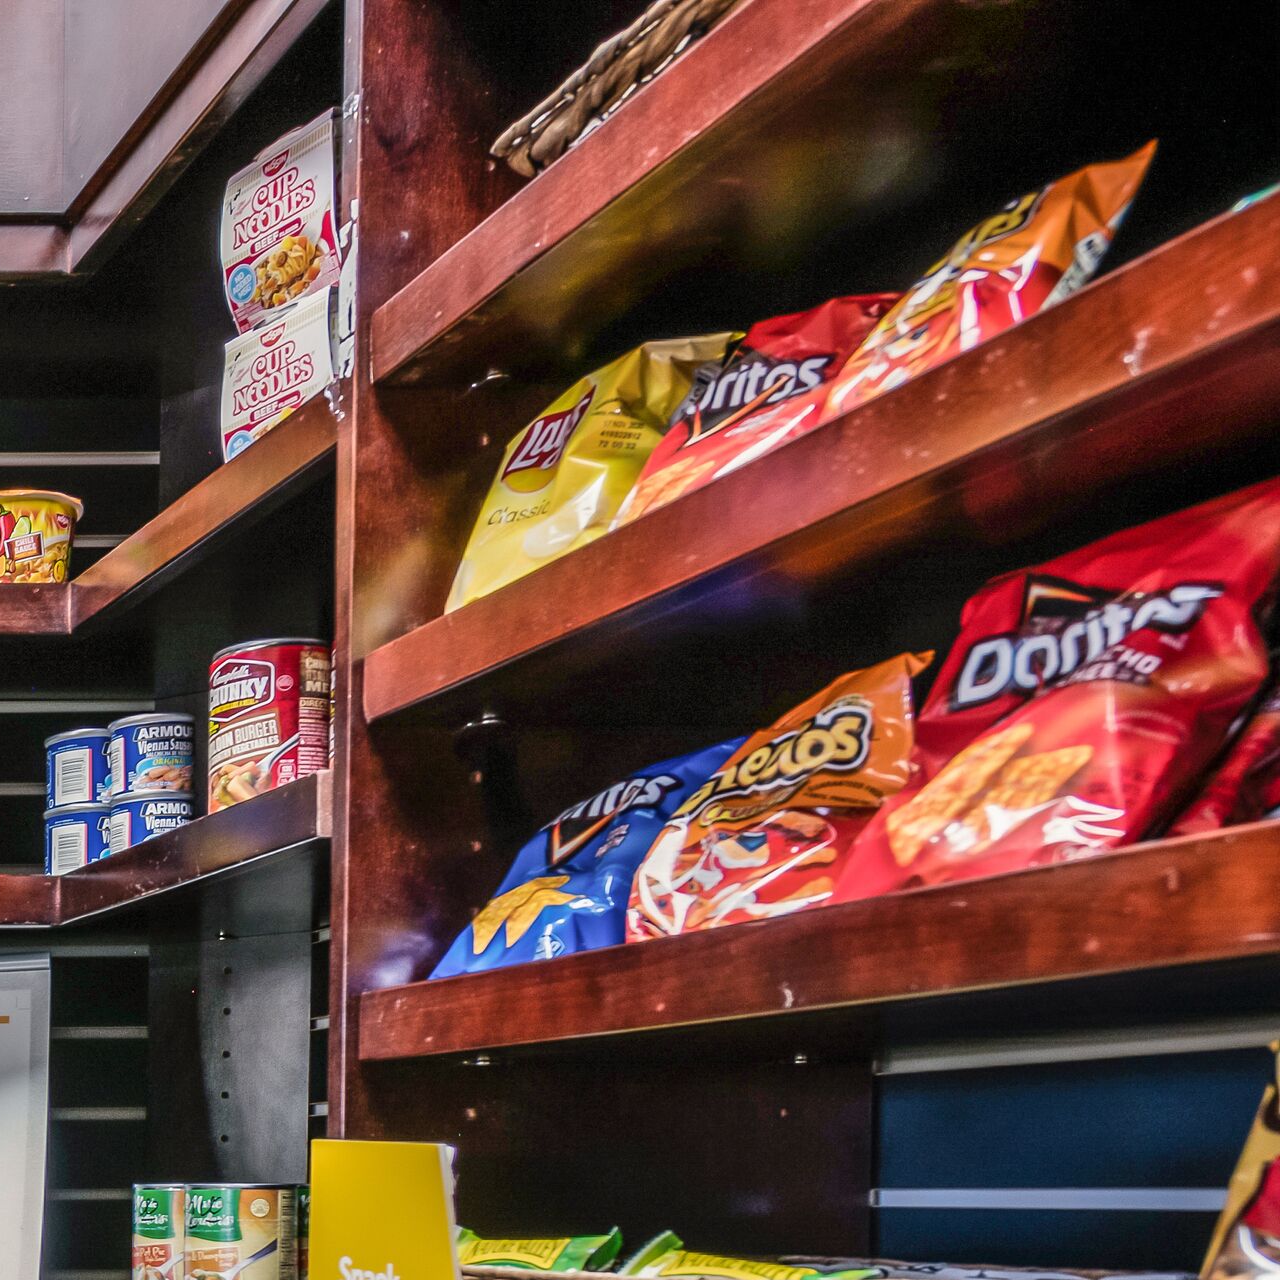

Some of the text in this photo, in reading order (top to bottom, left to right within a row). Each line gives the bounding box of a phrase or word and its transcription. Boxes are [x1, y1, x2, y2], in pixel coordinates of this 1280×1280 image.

[252, 166, 299, 213] CUP
[233, 178, 316, 250] NOODLES
[254, 231, 280, 252] BEEF
[251, 340, 296, 382] CUP
[233, 354, 314, 416] NOODLES
[487, 500, 552, 527] Classic
[958, 584, 1225, 704] Doritos
[138, 740, 169, 755] Vienna
[234, 719, 278, 744] BURGER
[146, 816, 176, 831] Vienna
